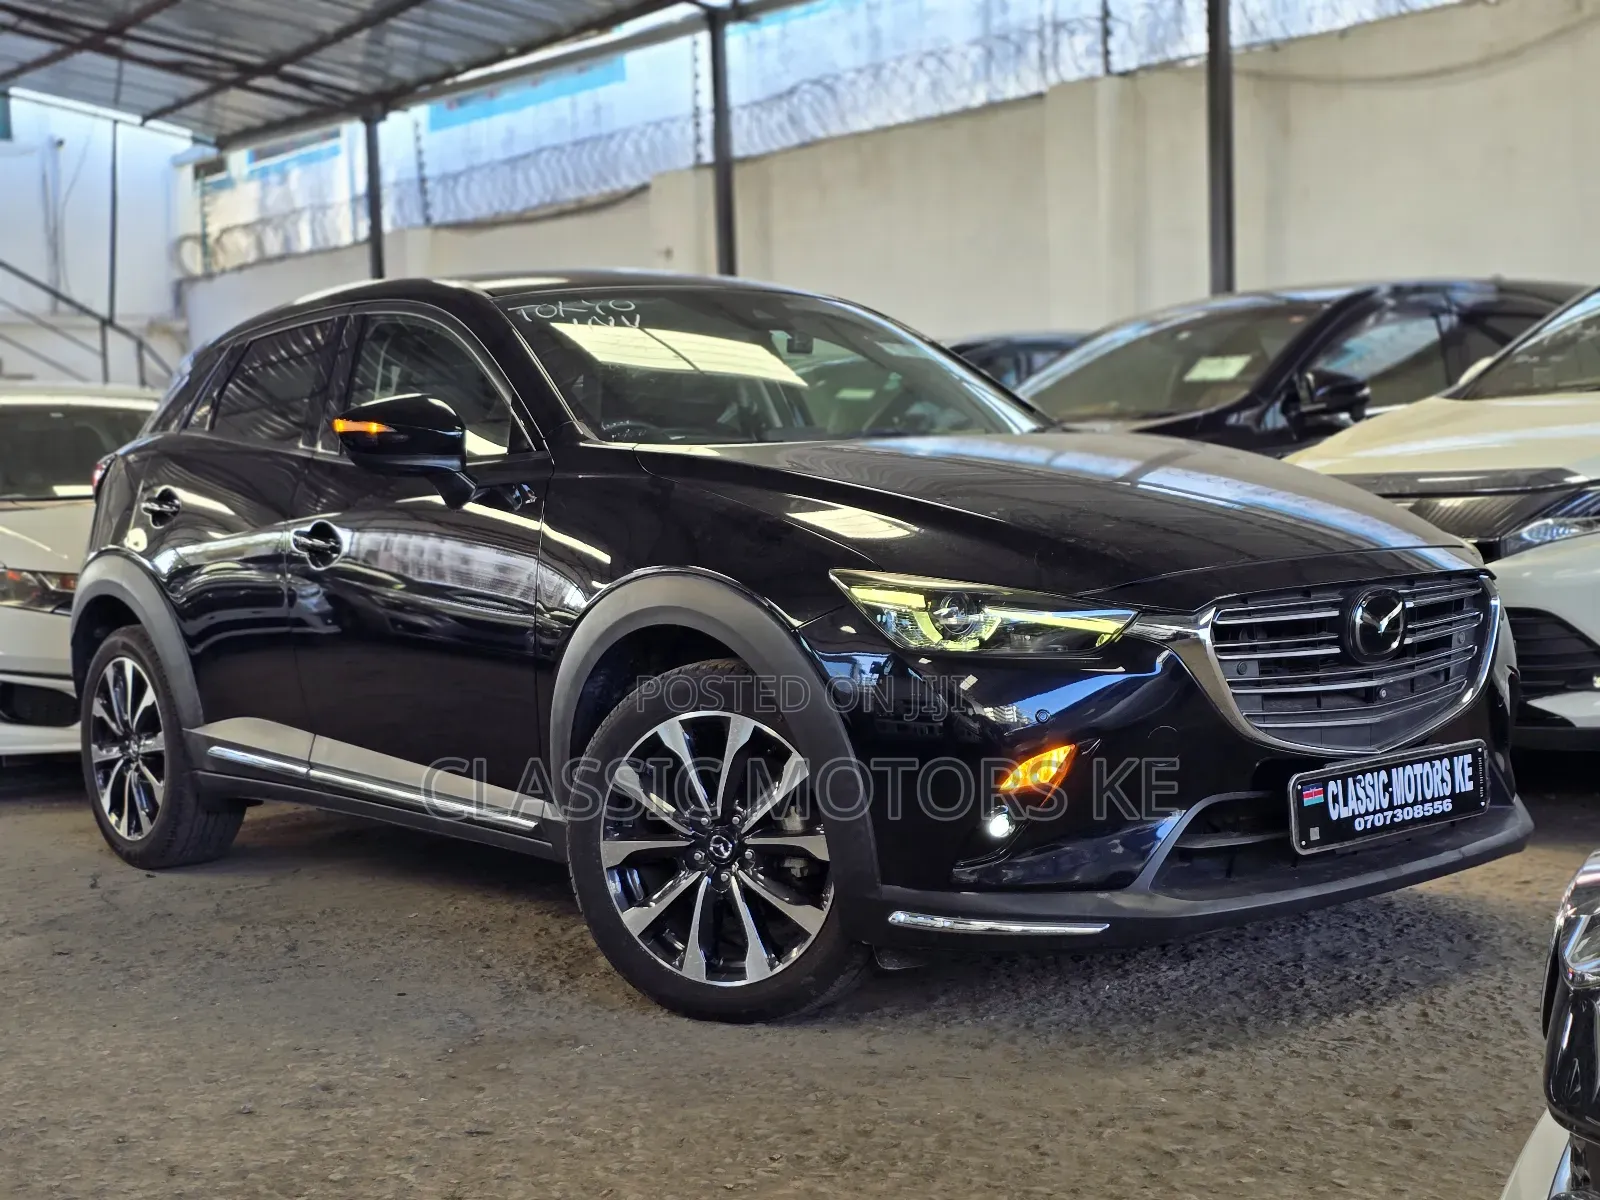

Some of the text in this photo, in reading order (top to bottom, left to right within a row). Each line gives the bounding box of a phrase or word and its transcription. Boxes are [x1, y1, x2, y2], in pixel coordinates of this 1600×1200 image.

[507, 299, 636, 321] TOKYO
[1453, 753, 1474, 794] KE
[1354, 798, 1453, 832] 0707308556
